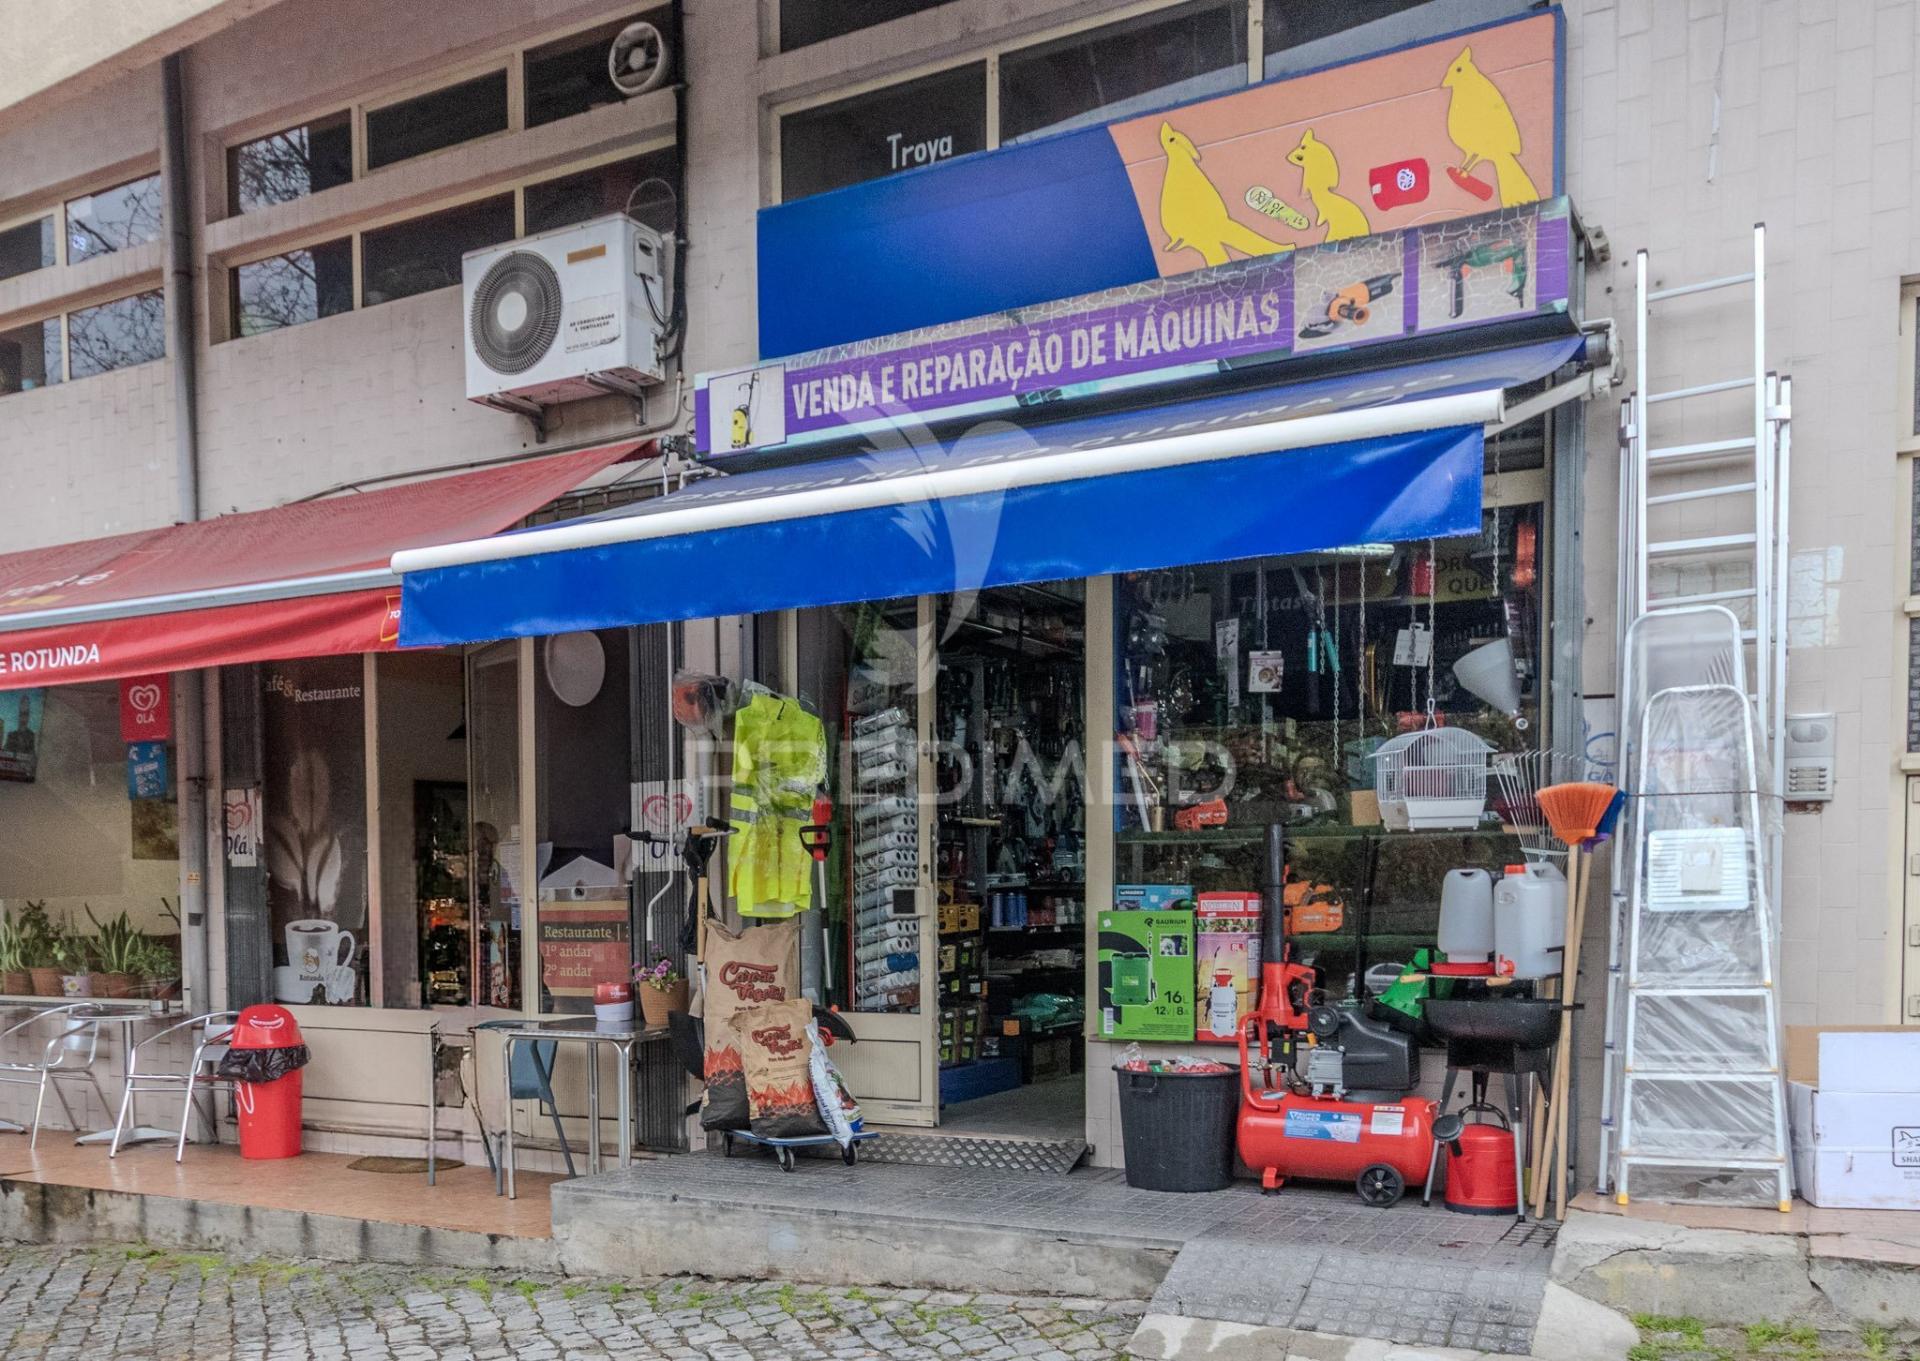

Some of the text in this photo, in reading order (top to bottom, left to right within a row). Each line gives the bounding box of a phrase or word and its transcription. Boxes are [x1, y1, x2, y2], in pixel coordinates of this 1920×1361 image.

[792, 291, 1280, 420] VENDA E REPARAÇÃO DE MÁQUINAS
[11, 643, 100, 673] ROTUNDA
[294, 685, 361, 702] Restaurante
[543, 925, 612, 939] Restaurante
[544, 944, 593, 957] 1º andar
[560, 963, 593, 977] andar
